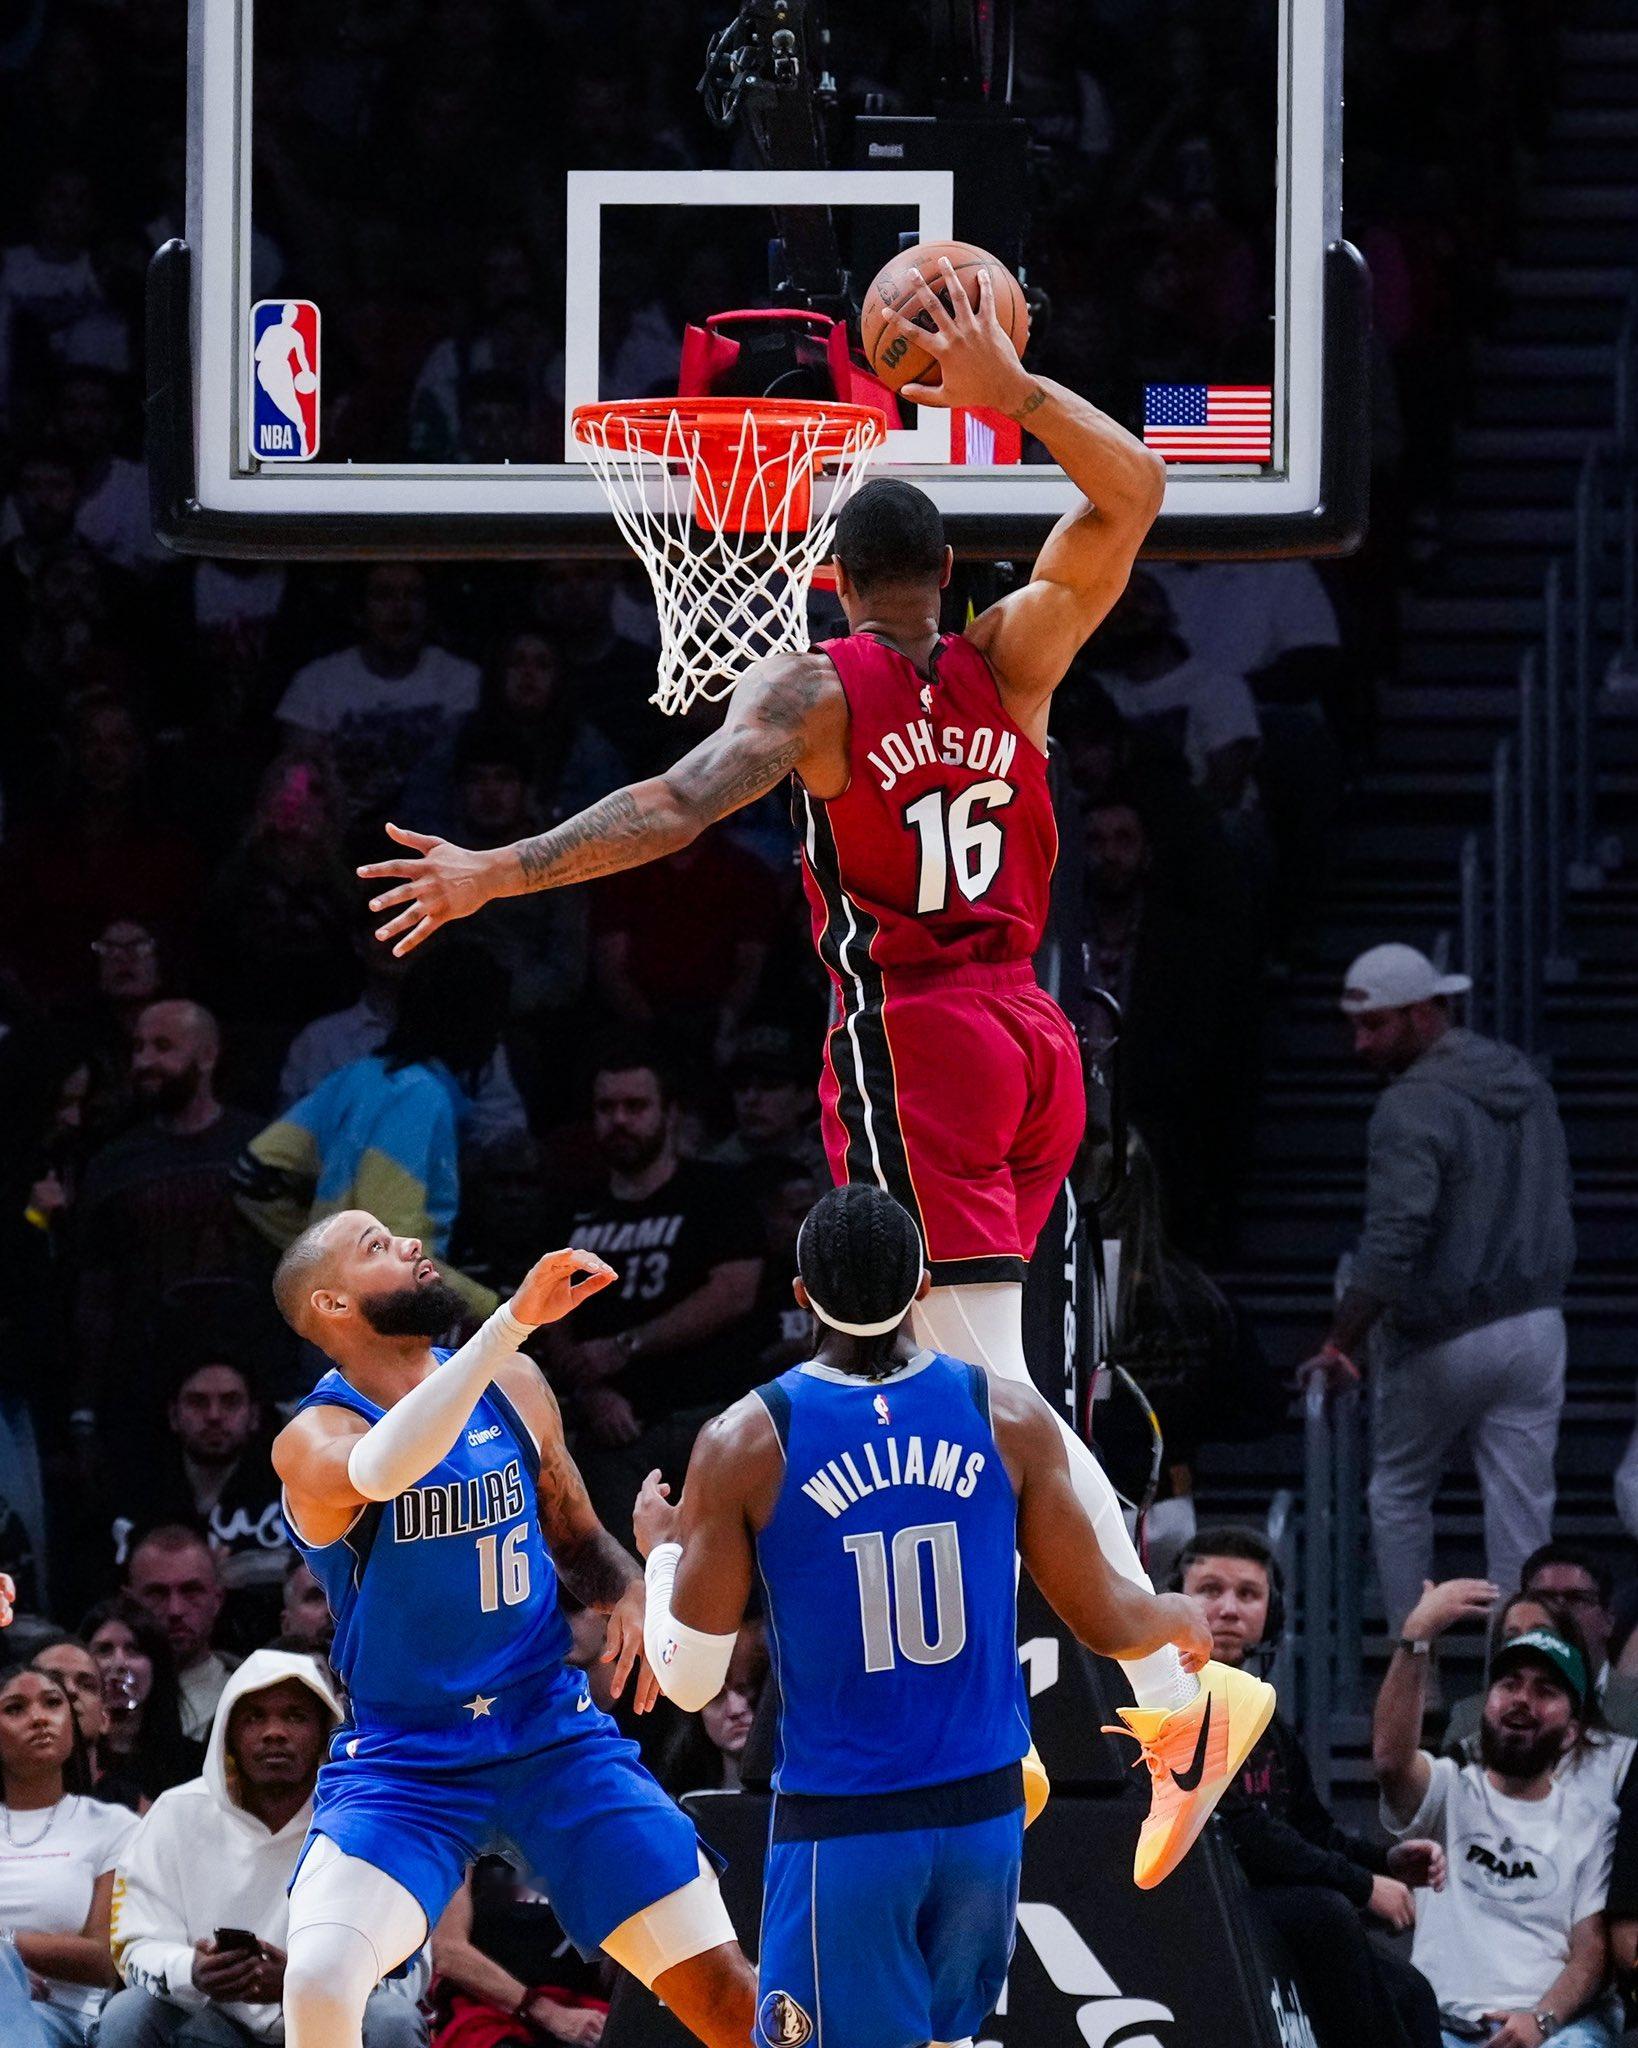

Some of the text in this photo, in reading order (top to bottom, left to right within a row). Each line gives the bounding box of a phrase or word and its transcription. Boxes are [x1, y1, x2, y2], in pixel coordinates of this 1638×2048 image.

[260, 424, 294, 450] NBA
[866, 718, 1017, 791] JOHSON
[904, 778, 1016, 915] 16
[569, 1214, 685, 1251] MIAMI
[621, 1252, 670, 1300] 13
[1064, 1176, 1078, 1430] AT&T
[468, 1424, 502, 1447] chime
[801, 1435, 986, 1519] WILLIAMS
[394, 1459, 525, 1543] DALLAS
[475, 1522, 531, 1613] 16
[842, 1521, 967, 1673] 10
